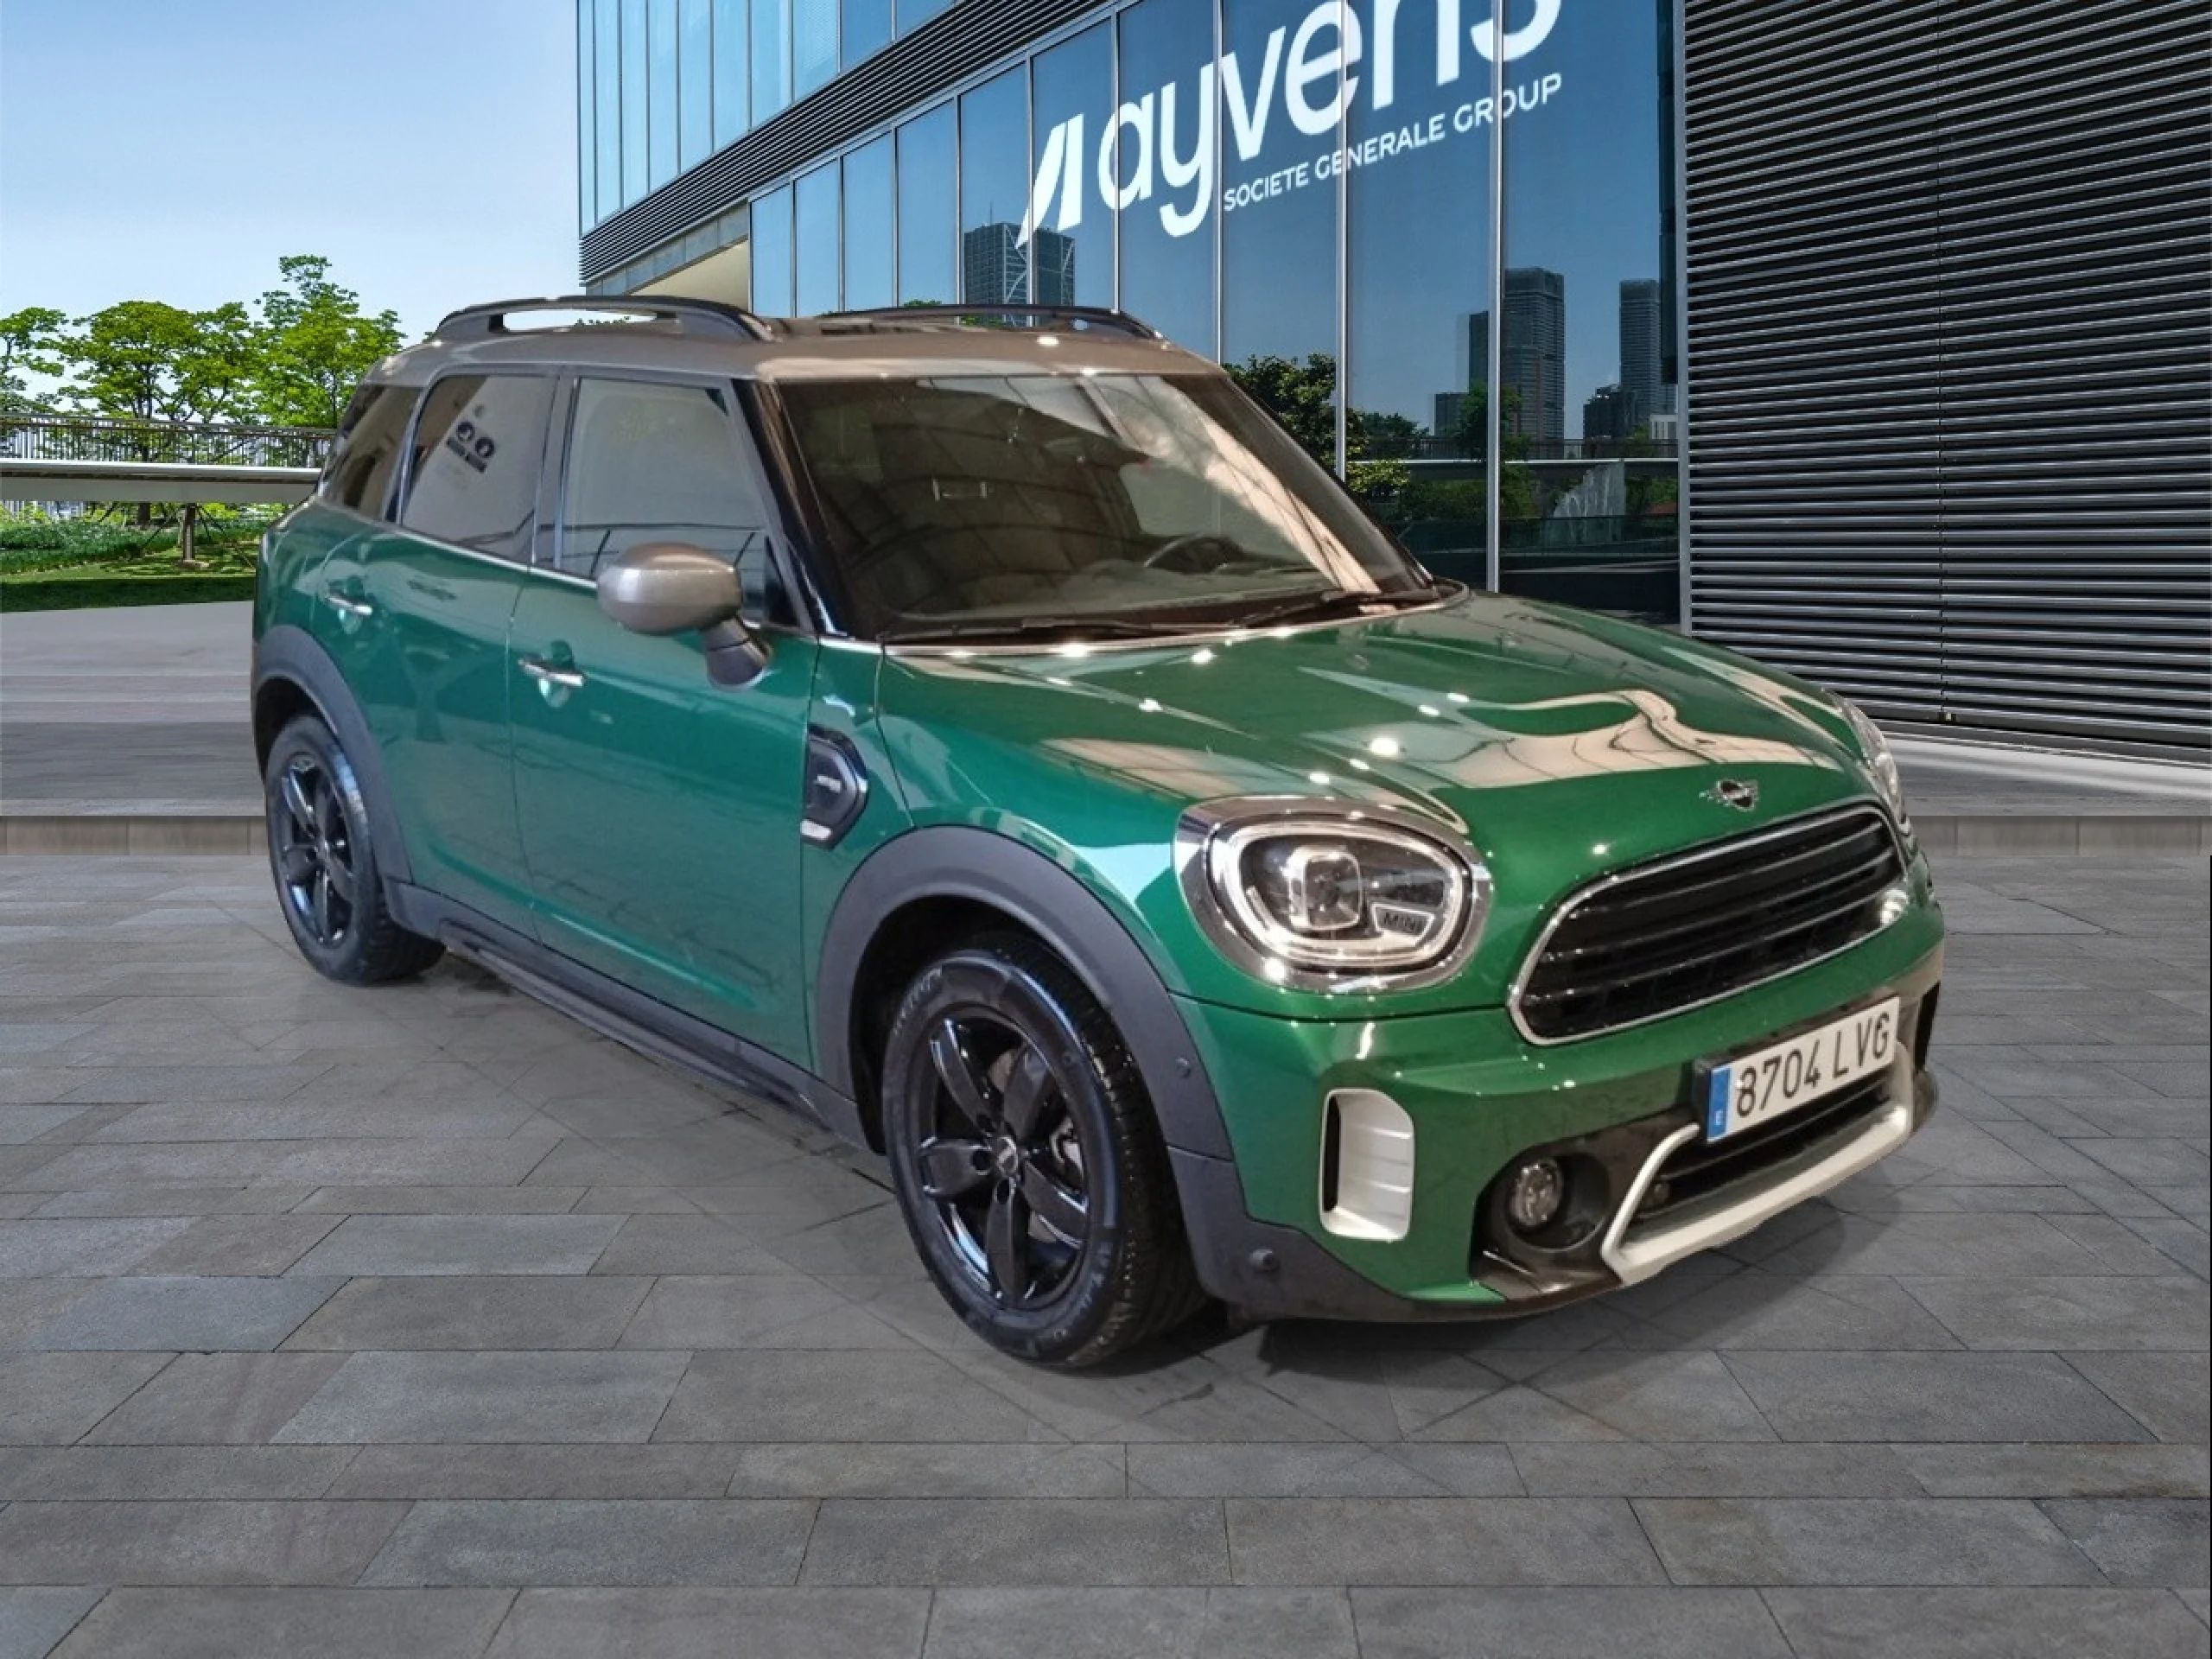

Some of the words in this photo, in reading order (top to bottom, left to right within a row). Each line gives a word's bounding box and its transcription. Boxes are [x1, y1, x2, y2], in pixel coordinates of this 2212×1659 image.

[1223, 162, 1309, 212] SOCIETE
[1314, 113, 1445, 180] GENERALE
[1736, 1039, 1821, 1117] 8704
[1833, 1012, 1890, 1079] LVG
